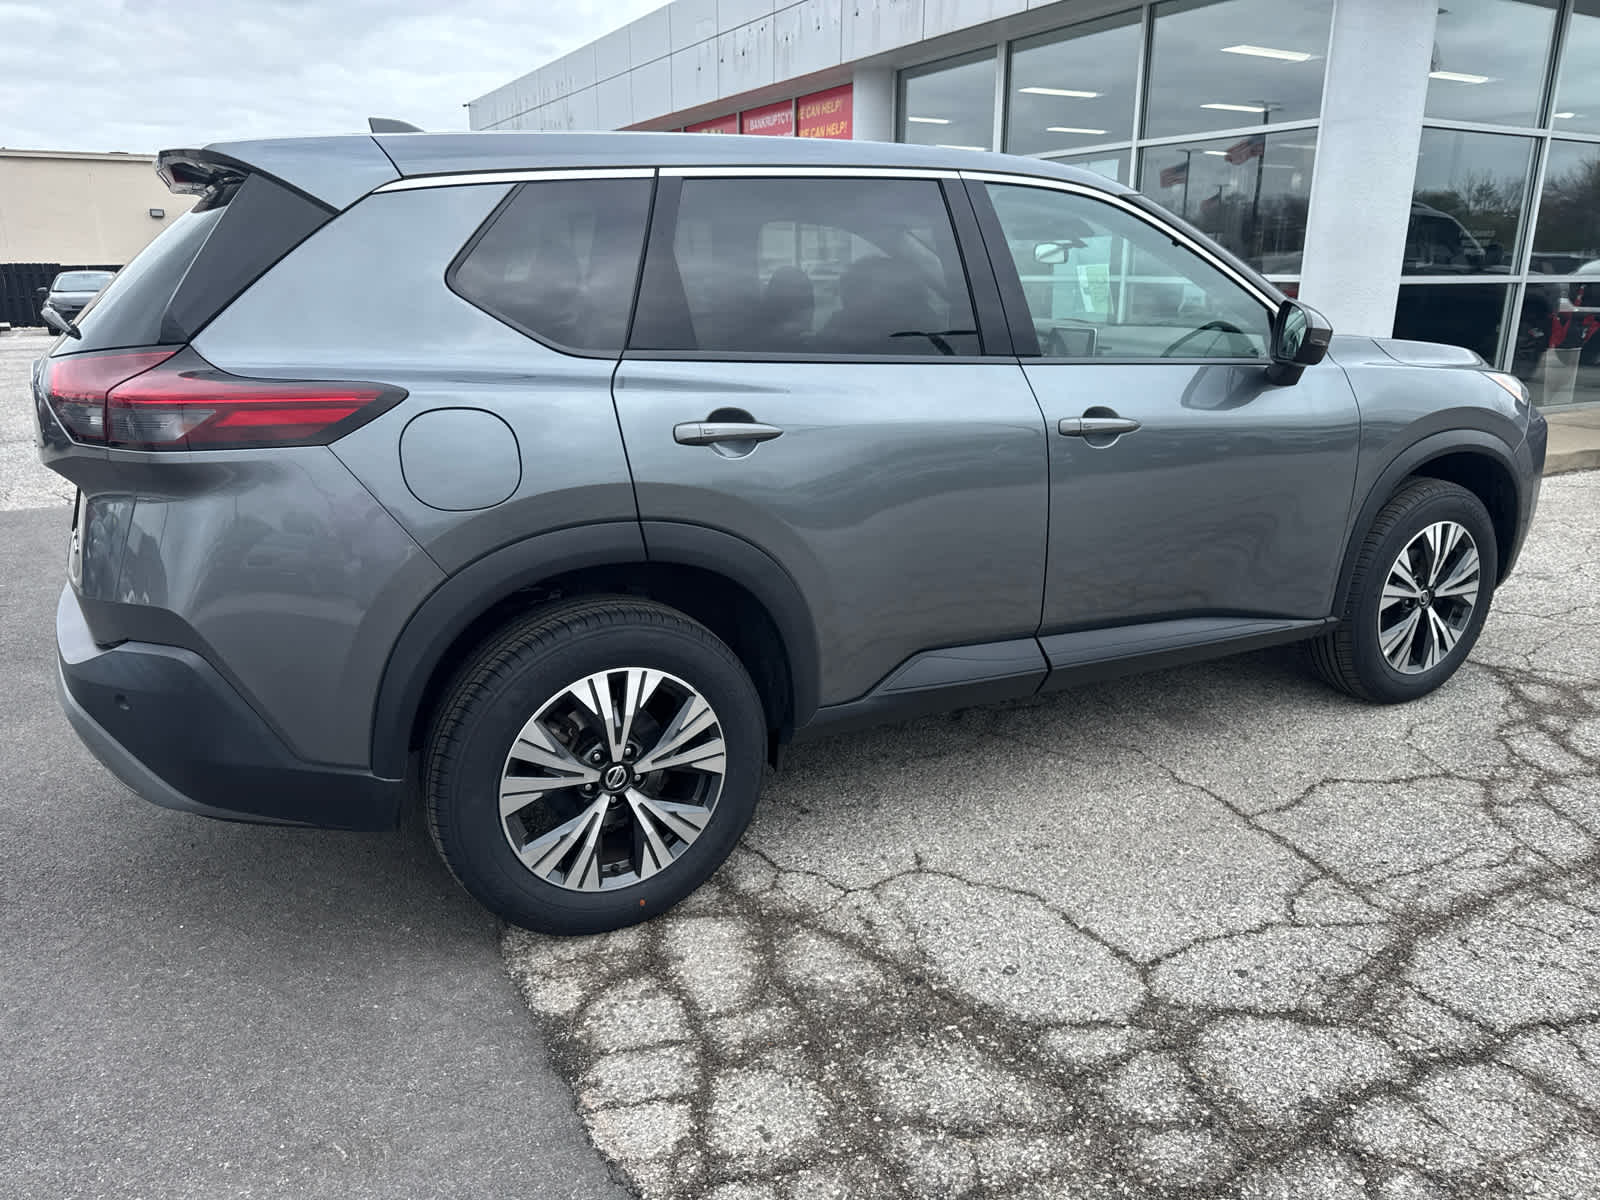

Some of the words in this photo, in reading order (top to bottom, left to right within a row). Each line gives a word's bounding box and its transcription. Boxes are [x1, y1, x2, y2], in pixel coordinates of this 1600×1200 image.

[806, 103, 820, 118] CAN
[821, 98, 843, 114] HELP!
[810, 124, 824, 138] CAN
[825, 120, 848, 137] HELP!
